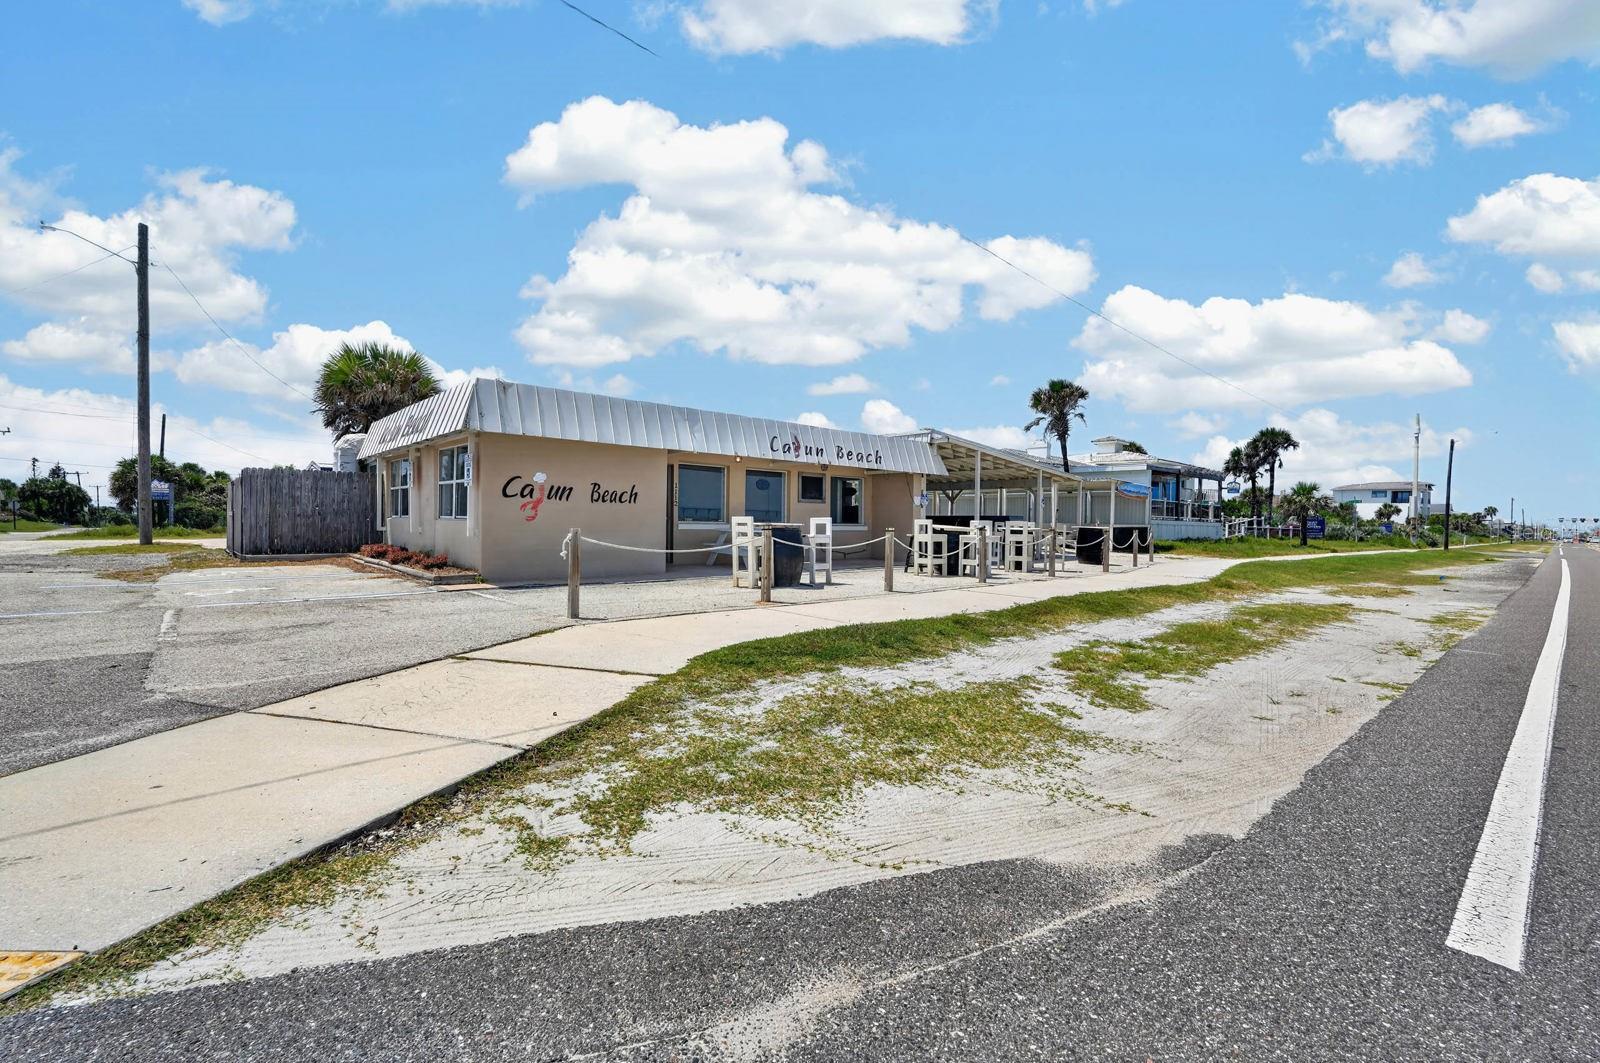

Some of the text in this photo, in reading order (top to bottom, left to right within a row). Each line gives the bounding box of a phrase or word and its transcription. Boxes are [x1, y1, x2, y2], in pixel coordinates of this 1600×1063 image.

[770, 433, 882, 464] Cajun Beach
[501, 472, 639, 522] Cajun Beach
